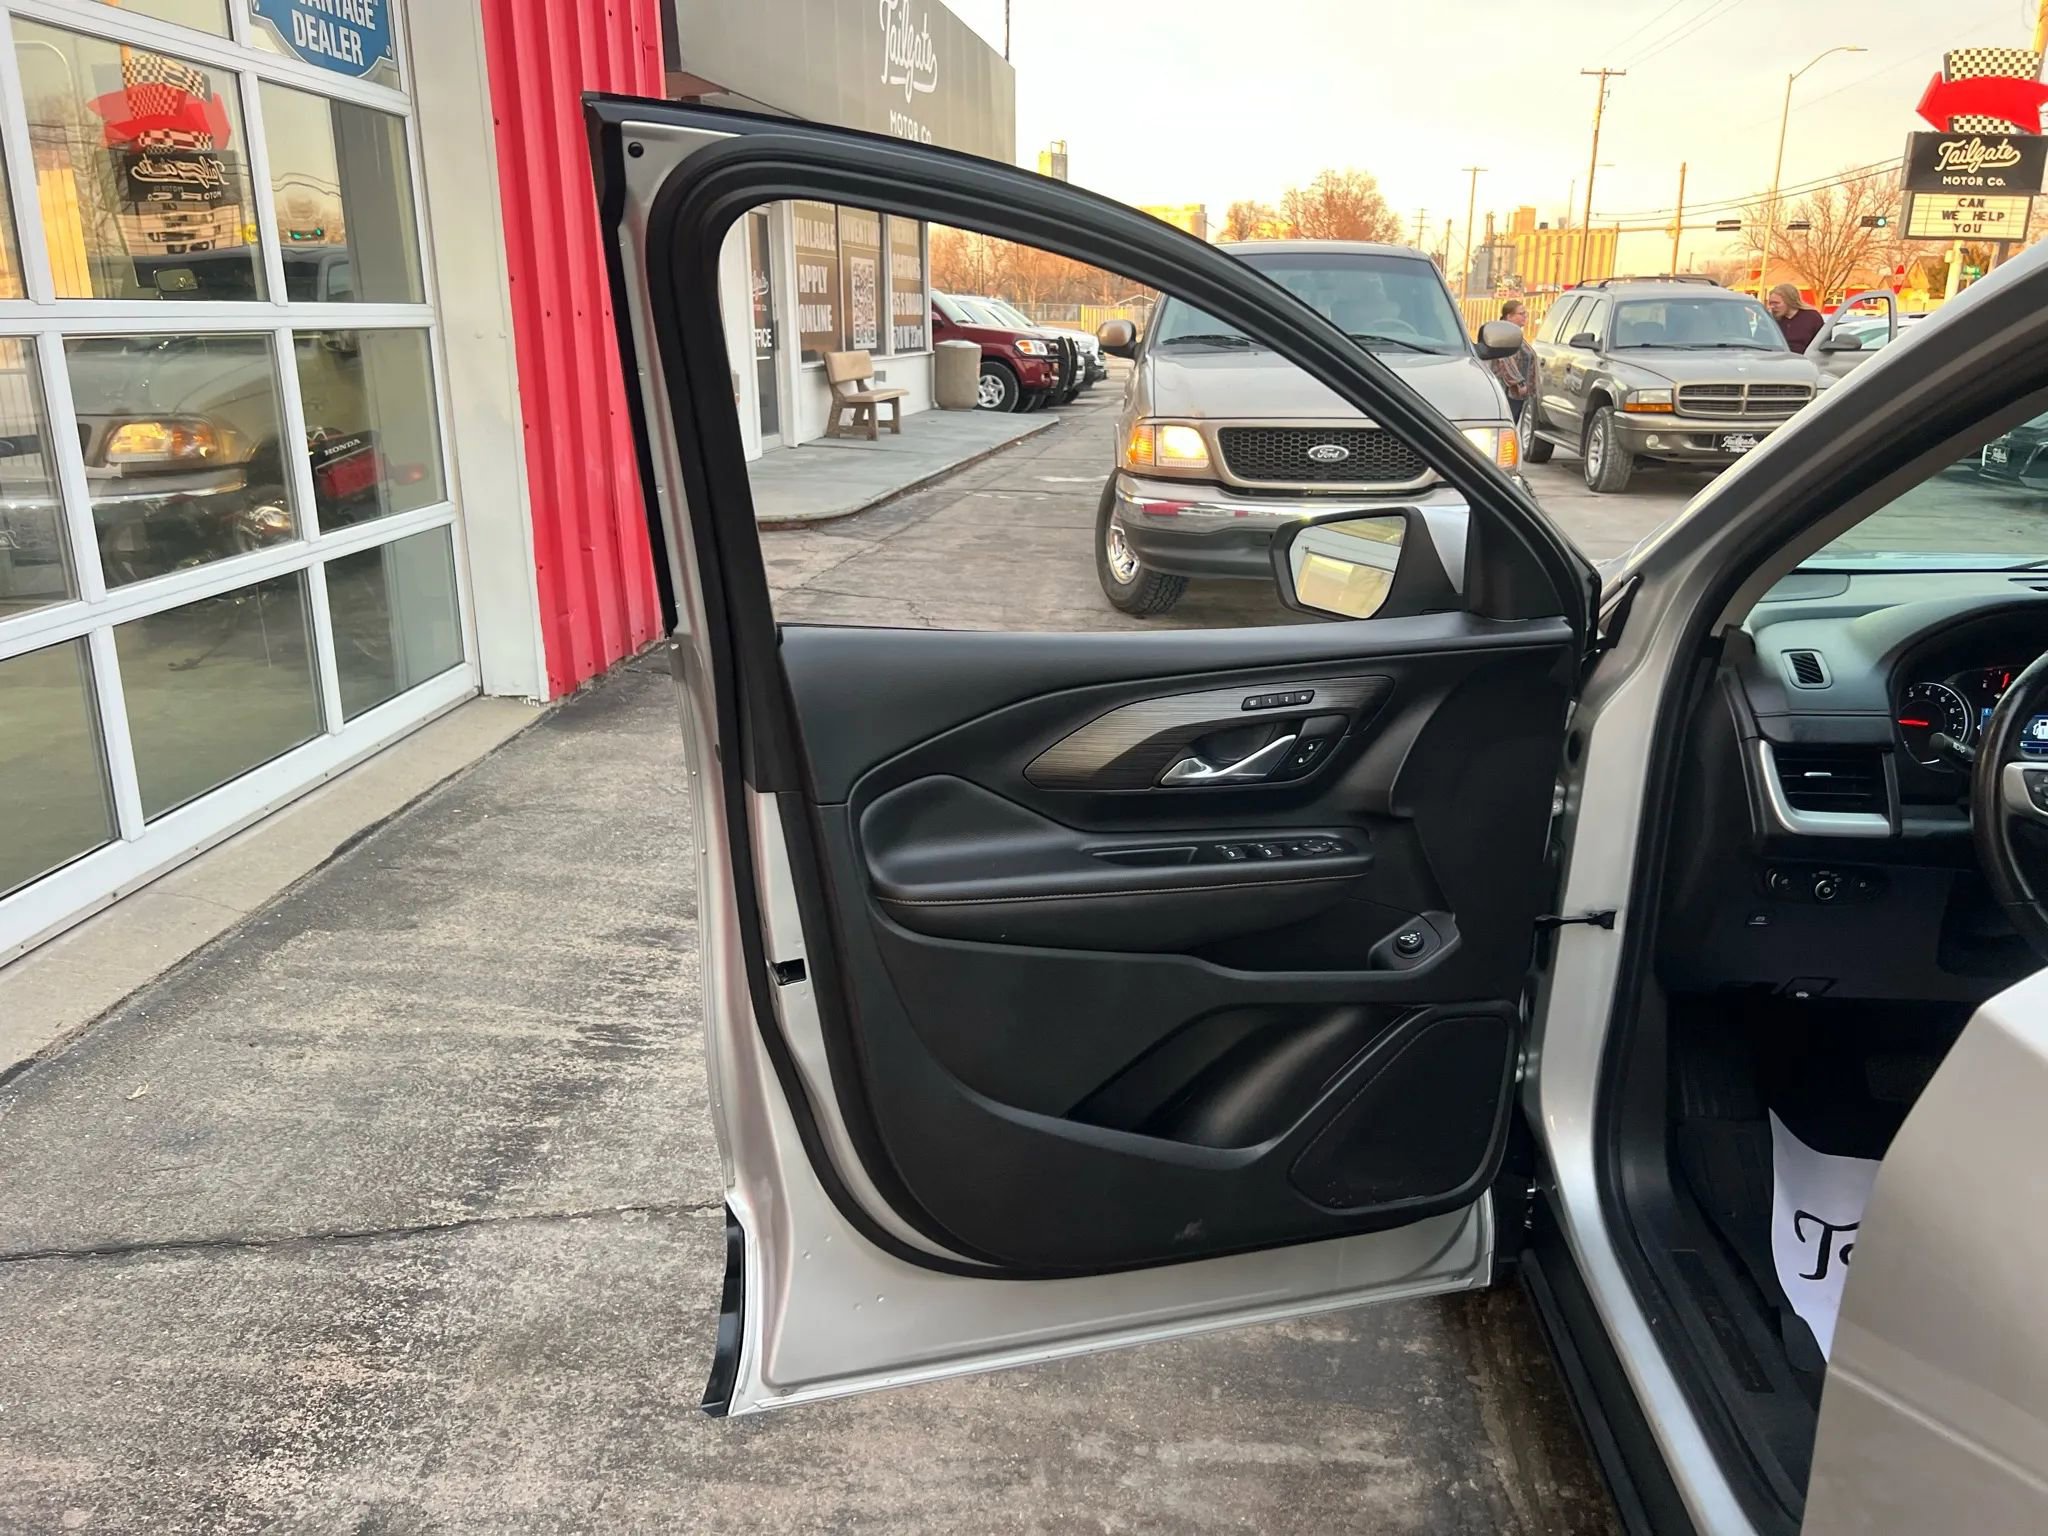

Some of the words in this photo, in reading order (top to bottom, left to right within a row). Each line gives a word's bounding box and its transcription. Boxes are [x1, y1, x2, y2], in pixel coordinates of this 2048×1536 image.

[299, 0, 377, 30] NTAGE
[291, 9, 365, 66] DEALER
[879, 0, 938, 104] Tailgate
[889, 109, 919, 142] MOTOR
[1934, 137, 2022, 174] Tailgate
[1942, 176, 1983, 186] MOTOR
[1942, 210, 1960, 220] WE
[1973, 211, 2005, 222] HELP
[1958, 198, 1985, 208] CAN
[1954, 223, 1982, 233] YOU
[799, 264, 828, 293] APPLY
[799, 304, 833, 333] ONLINE
[323, 438, 361, 456] HONDA
